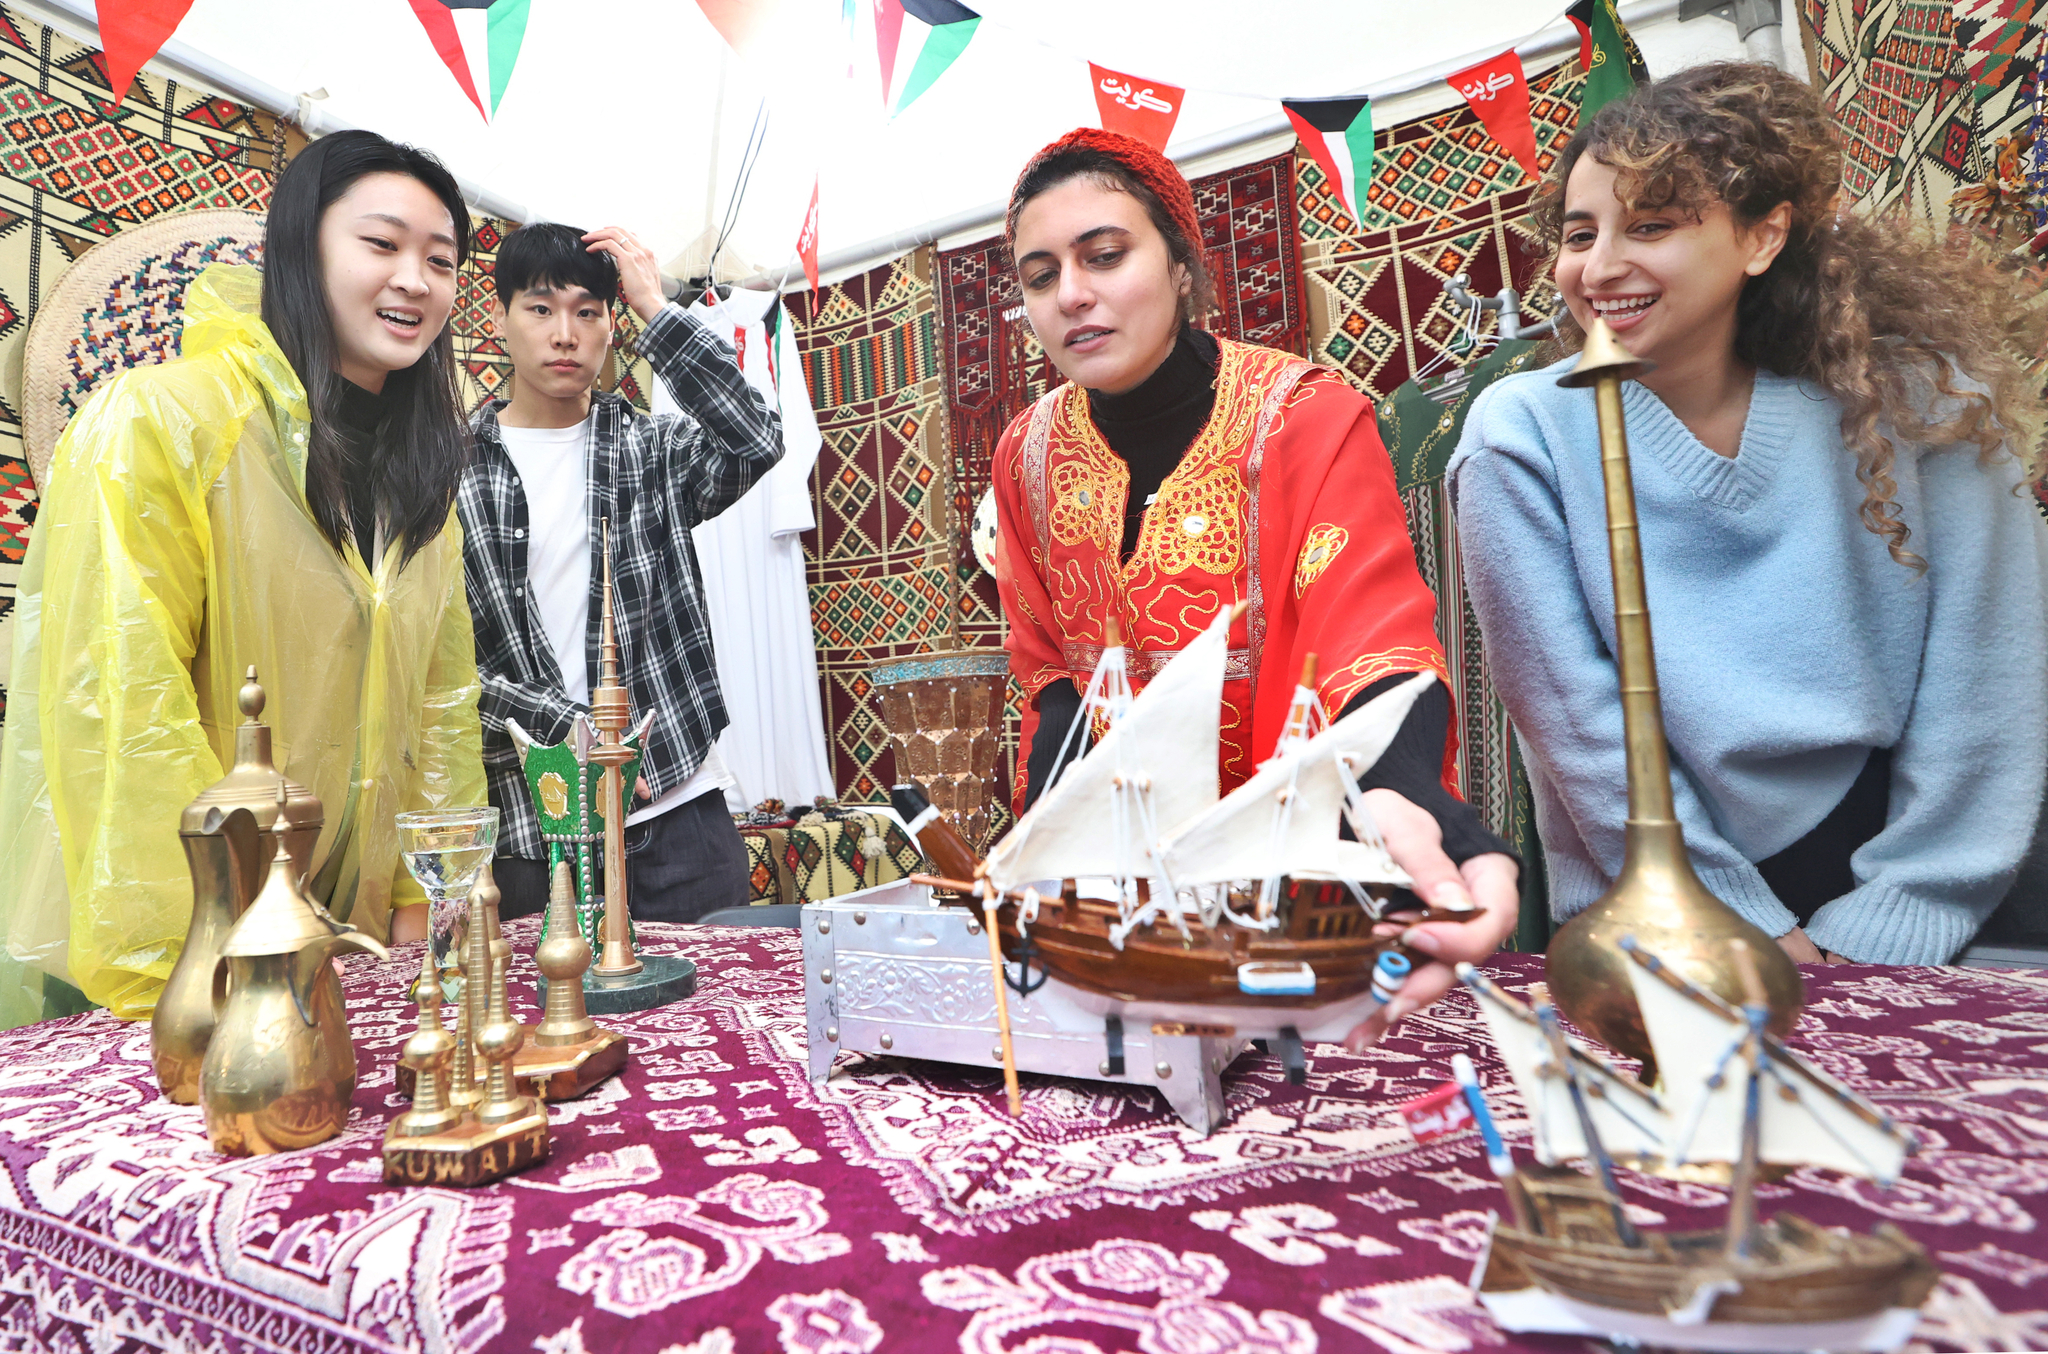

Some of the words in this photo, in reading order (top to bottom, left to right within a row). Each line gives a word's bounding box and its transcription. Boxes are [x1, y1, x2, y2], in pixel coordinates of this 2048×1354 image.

[1100, 78, 1173, 114] كويت
[1462, 72, 1515, 101] كويت
[383, 1127, 547, 1183] KUWAIT
